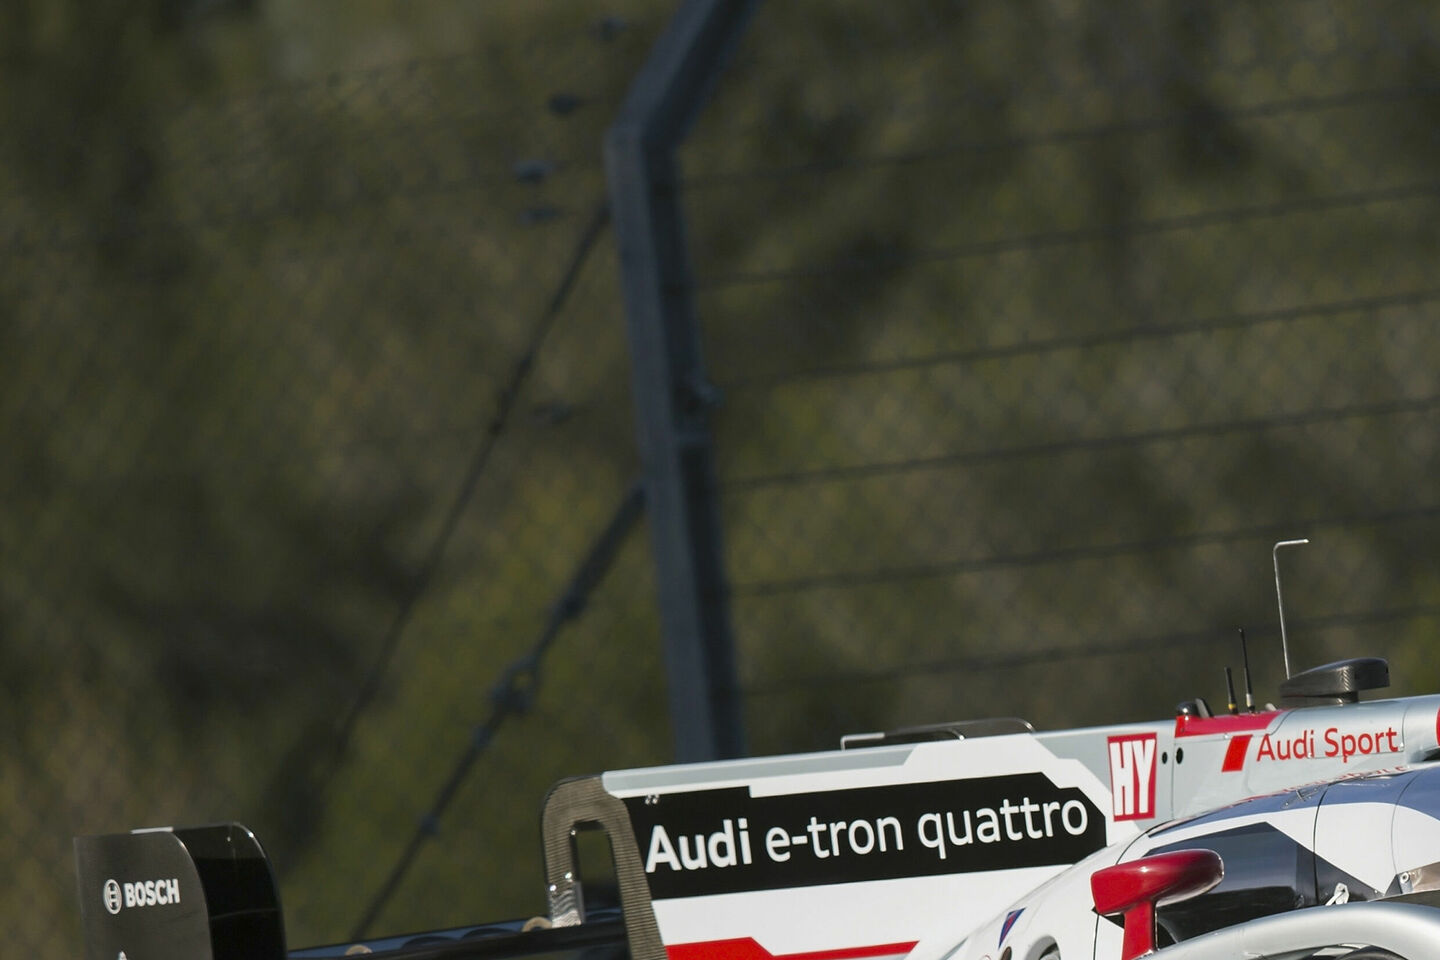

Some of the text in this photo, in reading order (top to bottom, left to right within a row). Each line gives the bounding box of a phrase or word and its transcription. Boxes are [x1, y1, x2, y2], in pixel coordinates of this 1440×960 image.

[1257, 726, 1399, 764] Audi Sport
[1109, 739, 1156, 817] HY
[646, 797, 1089, 873] Audi e-tron quattro
[124, 878, 181, 908] BOSCH
